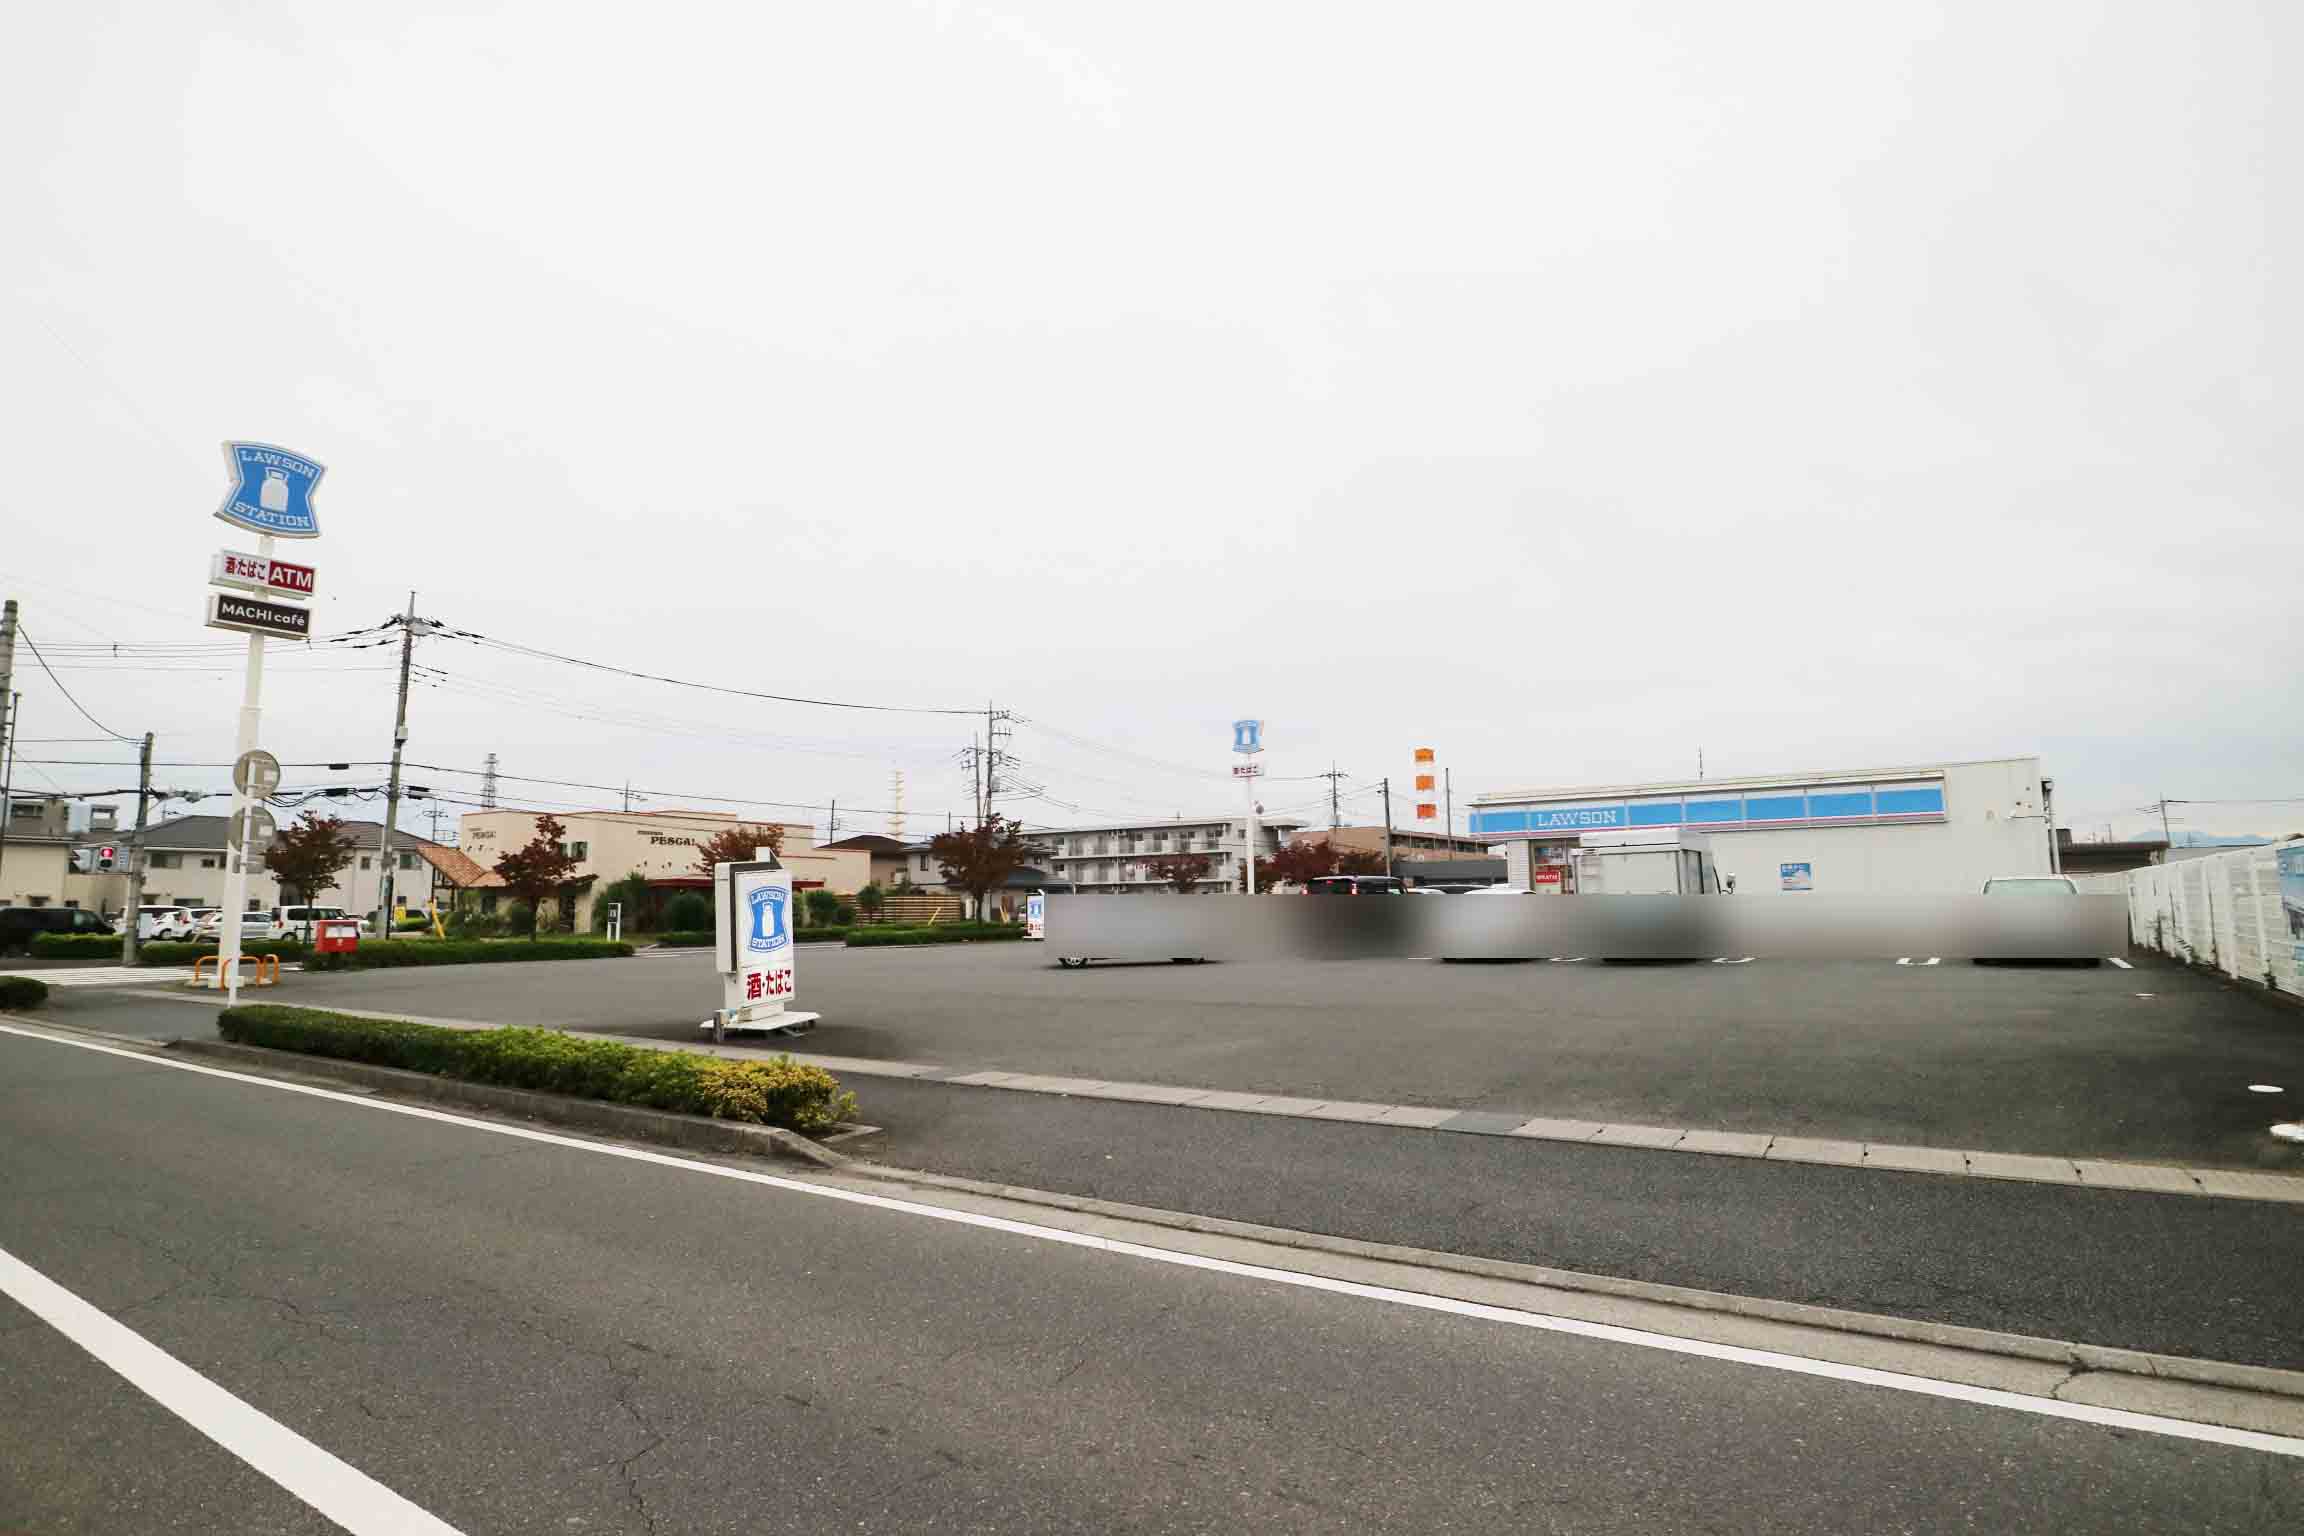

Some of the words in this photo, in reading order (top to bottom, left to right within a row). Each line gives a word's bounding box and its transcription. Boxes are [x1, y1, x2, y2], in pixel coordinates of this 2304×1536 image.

[240, 450, 315, 478] LAWSON
[233, 501, 311, 527] STATION
[270, 565, 313, 588] ATM
[222, 602, 272, 621] MACHI
[274, 614, 305, 626] café
[1537, 810, 1617, 826] LAWSON
[752, 890, 784, 904] LAWSON
[752, 935, 786, 948] STATION
